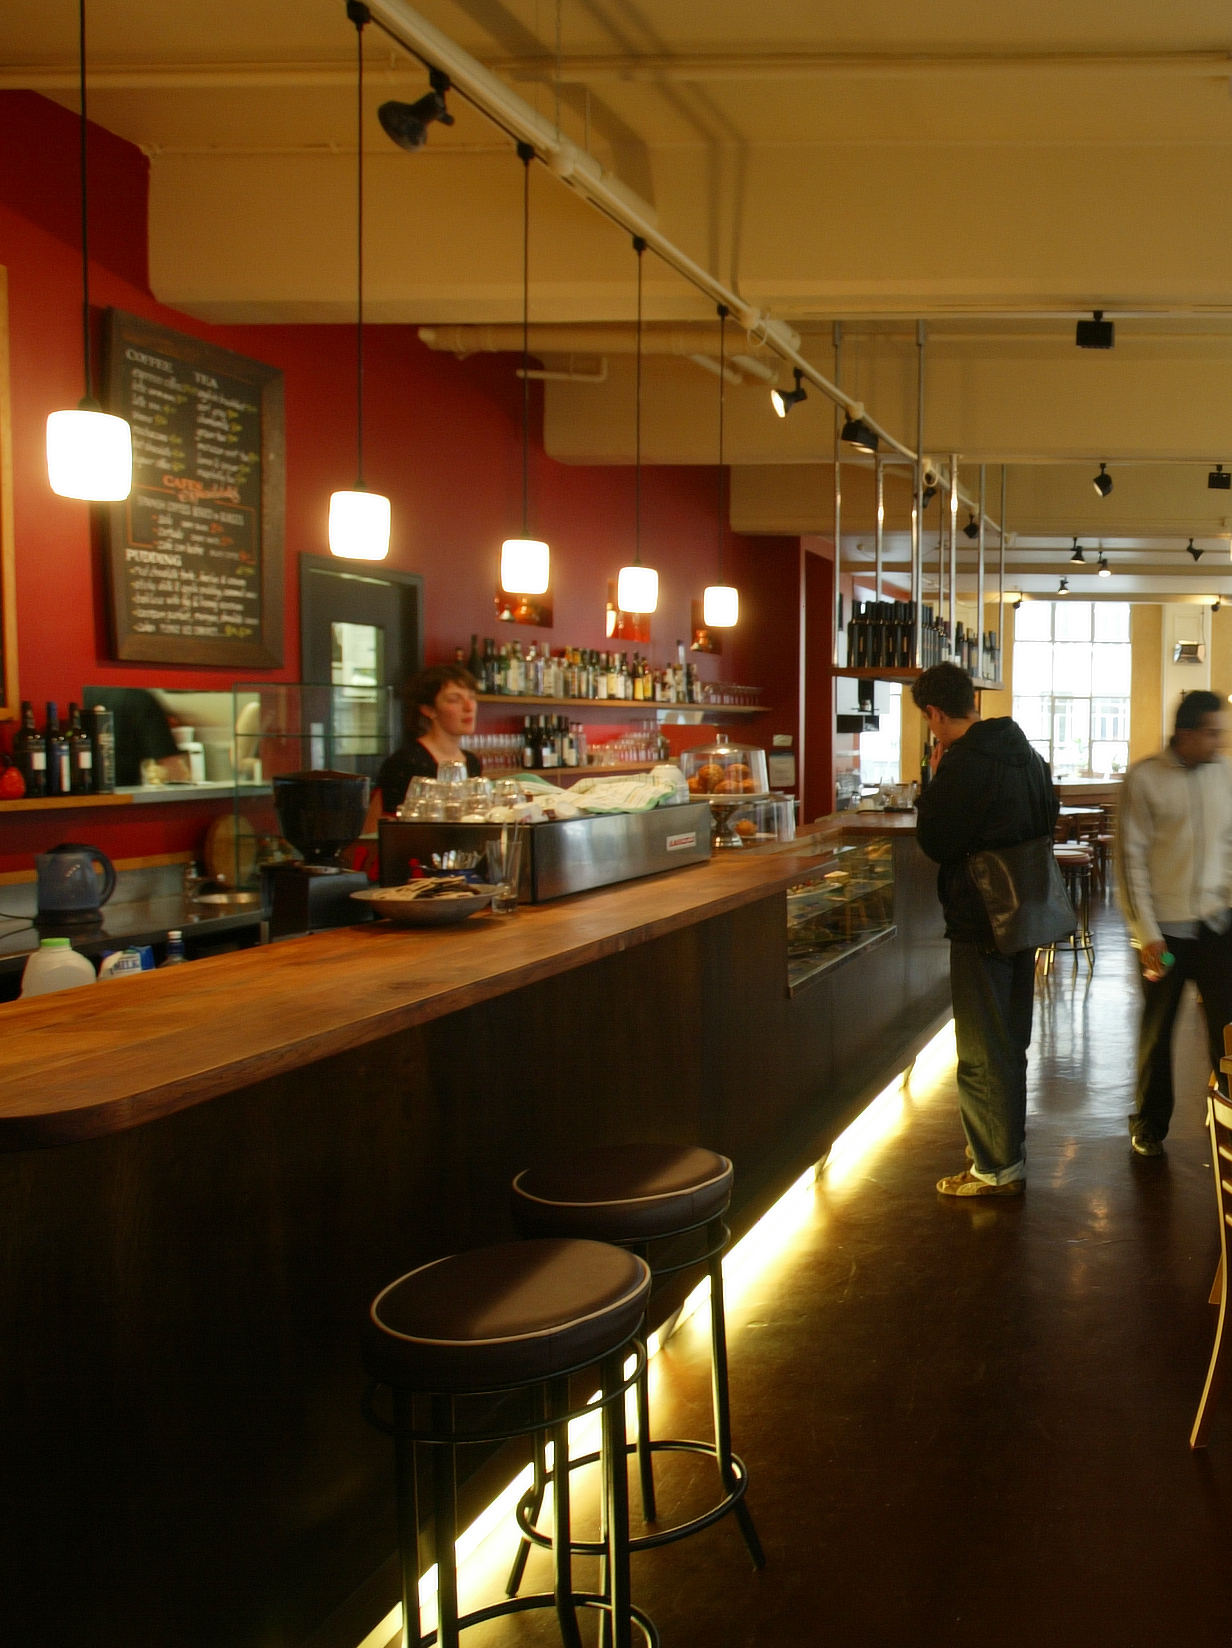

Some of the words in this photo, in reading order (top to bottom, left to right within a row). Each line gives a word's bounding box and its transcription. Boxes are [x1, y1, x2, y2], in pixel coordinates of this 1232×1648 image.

[125, 348, 173, 372] COFFEE
[194, 371, 219, 389] TEA
[125, 548, 183, 567] PUDDING
